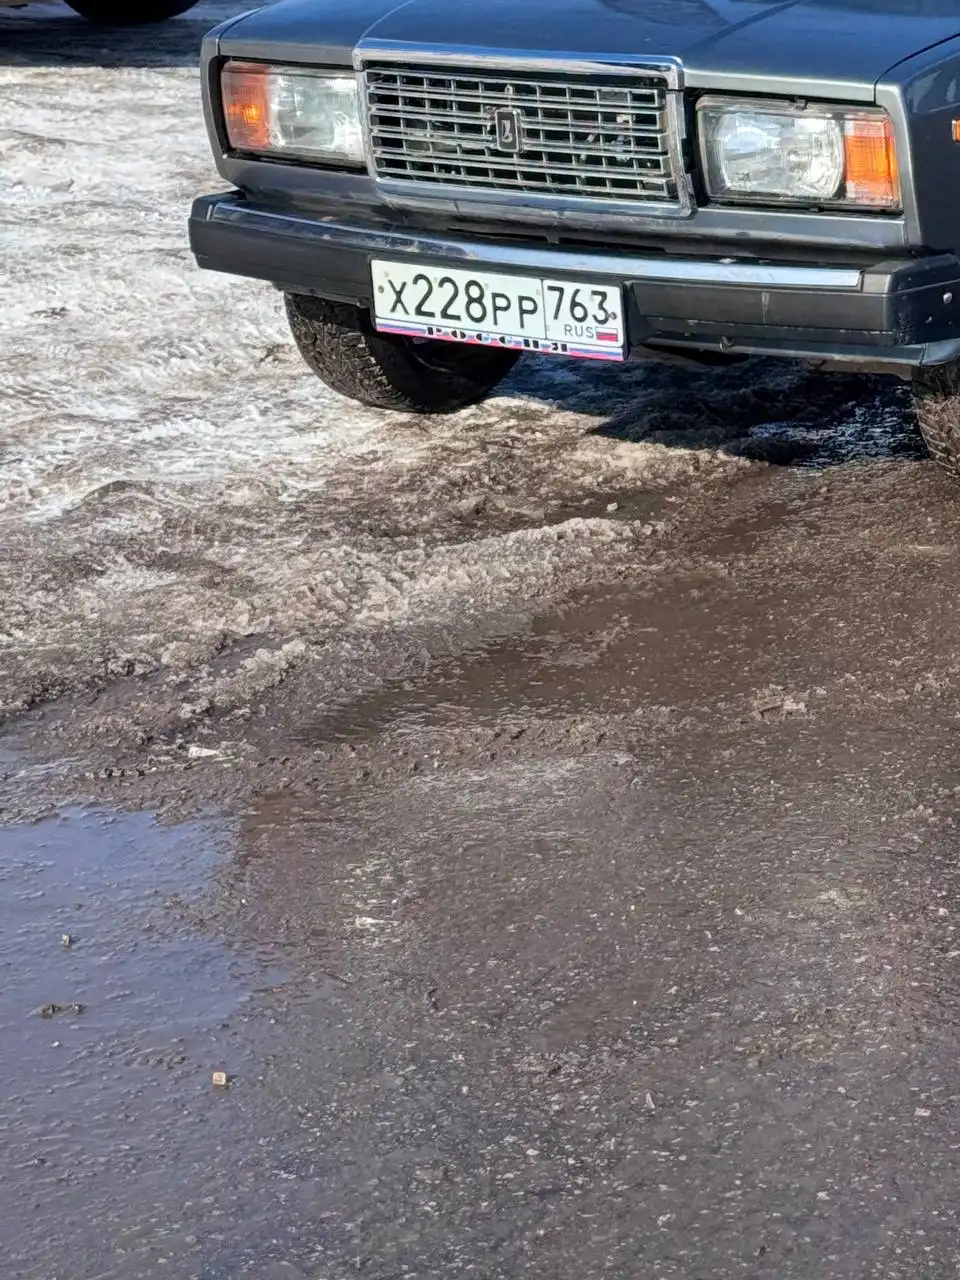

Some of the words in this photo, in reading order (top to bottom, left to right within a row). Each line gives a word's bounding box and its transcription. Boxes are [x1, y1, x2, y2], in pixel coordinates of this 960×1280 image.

[386, 273, 539, 330] Х228РР
[547, 285, 611, 325] 763
[563, 324, 595, 339] RUS
